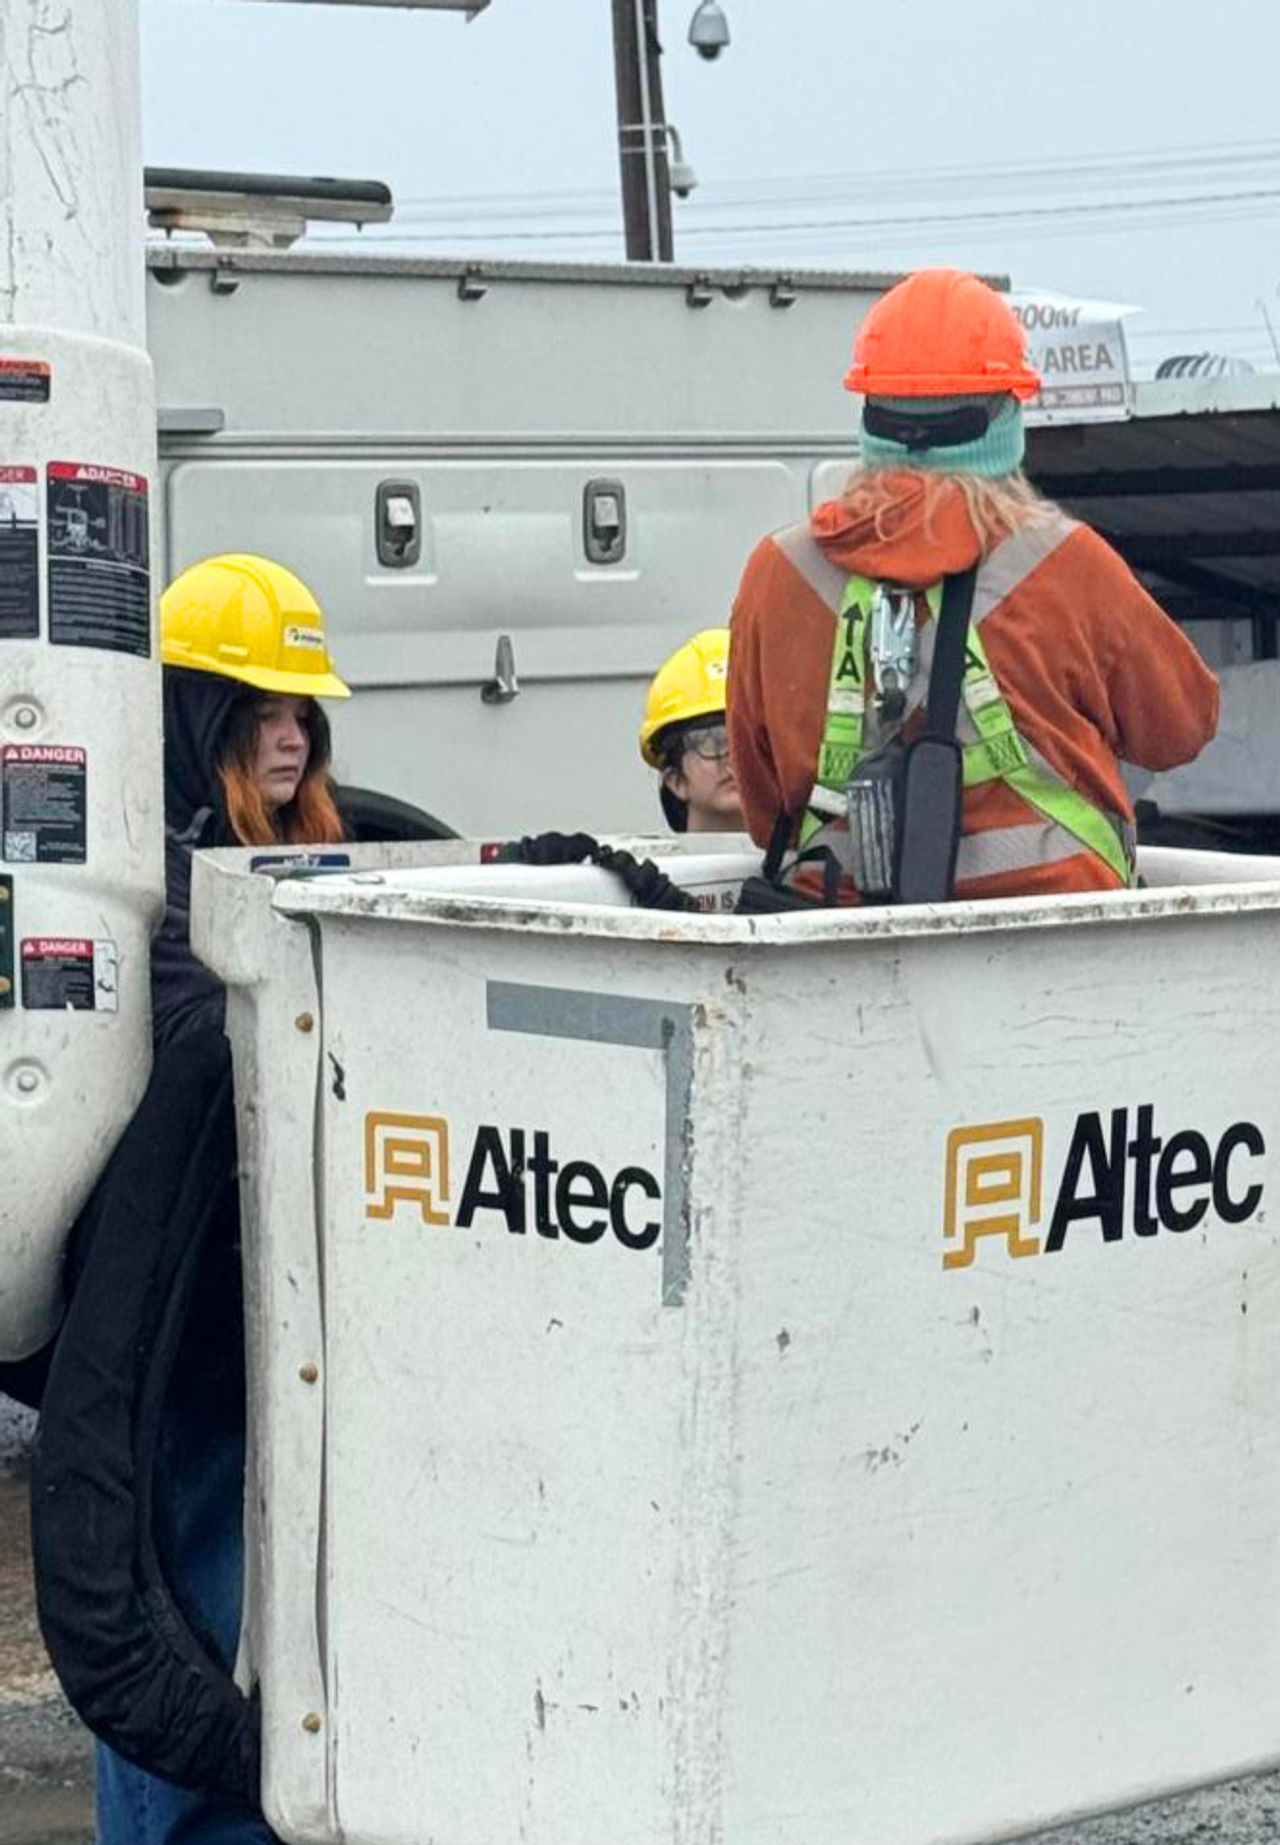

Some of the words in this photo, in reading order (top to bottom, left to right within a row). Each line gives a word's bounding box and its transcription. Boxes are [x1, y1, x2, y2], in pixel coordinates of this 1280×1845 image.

[1043, 343, 1114, 372] AREA
[836, 651, 861, 683] A
[20, 747, 84, 764] DANGER
[39, 941, 87, 954] DANGER
[455, 1124, 661, 1250] Altec
[1044, 1103, 1266, 1253] Altec
